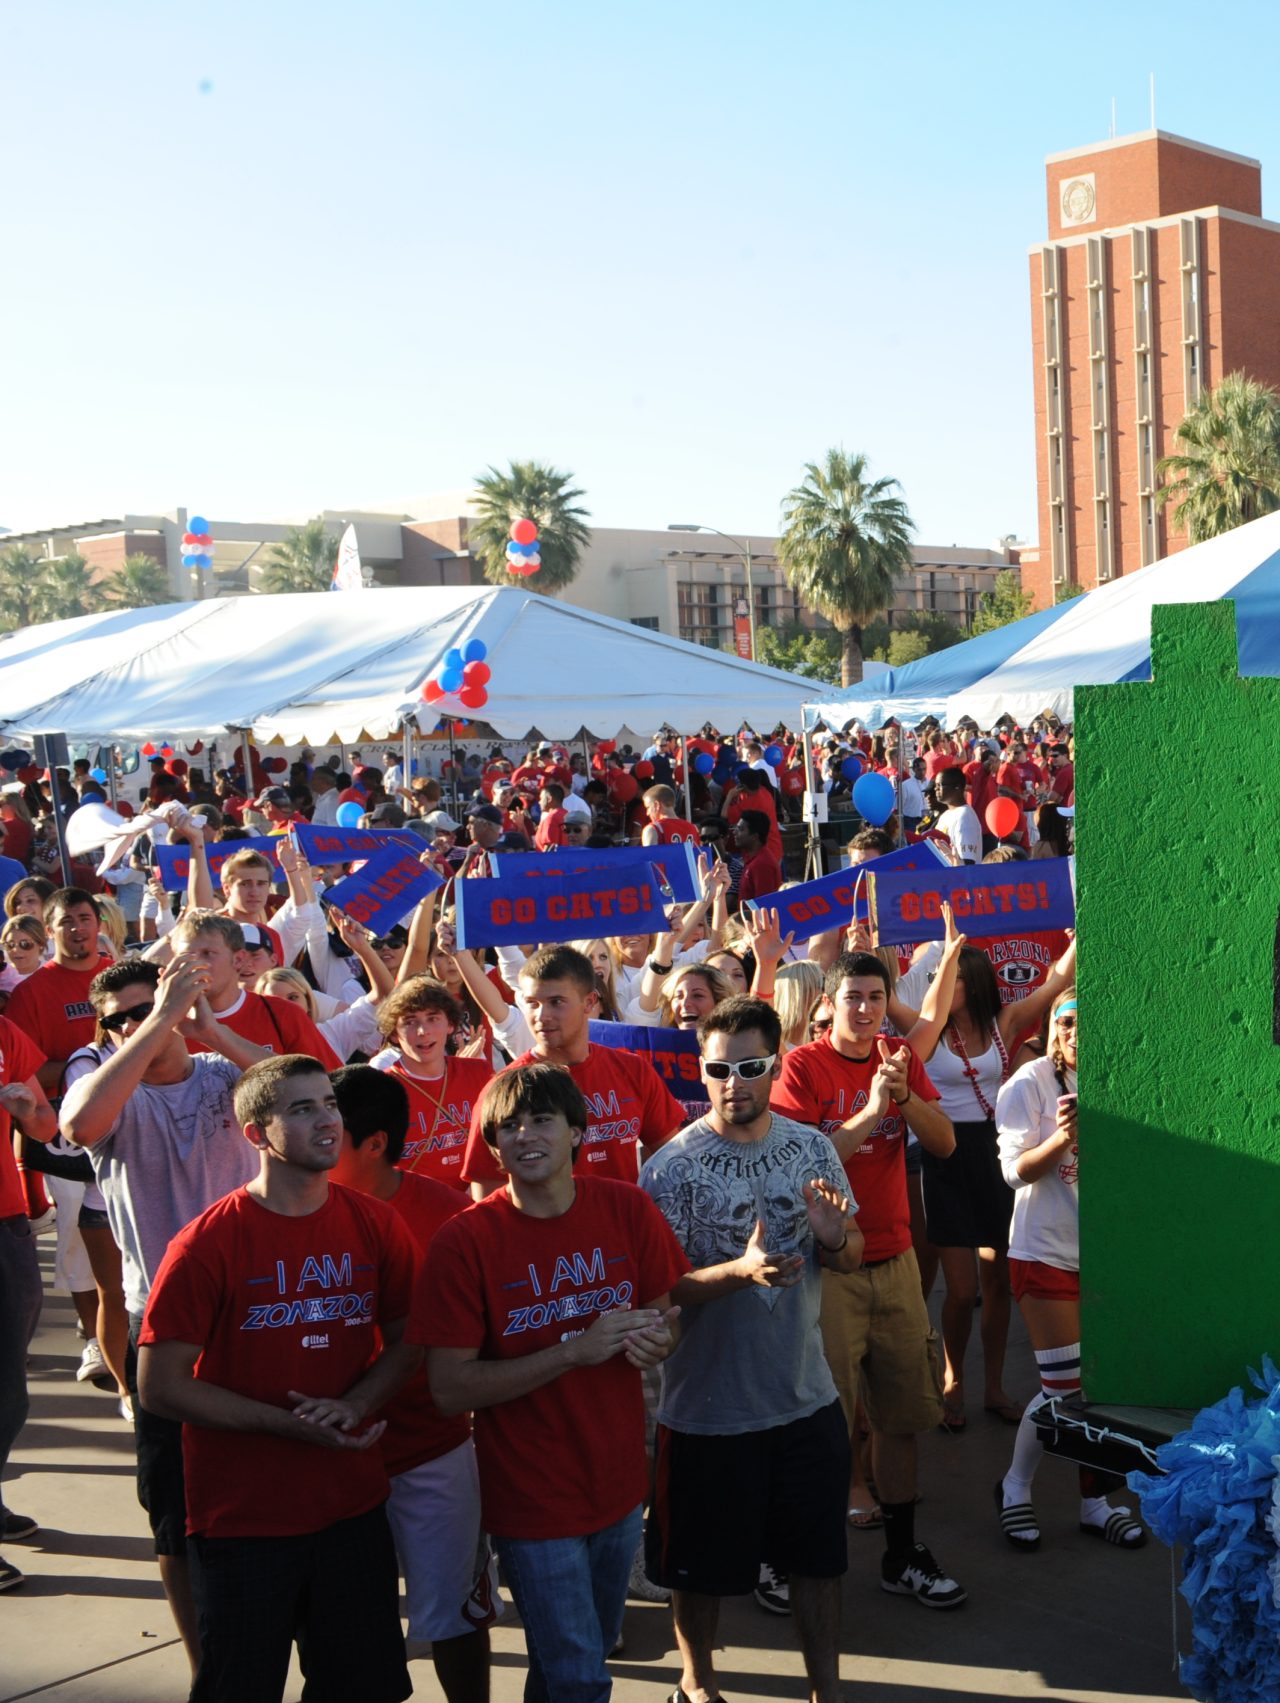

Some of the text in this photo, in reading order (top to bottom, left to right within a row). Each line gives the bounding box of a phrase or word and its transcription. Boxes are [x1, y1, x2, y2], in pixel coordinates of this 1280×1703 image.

[344, 894, 382, 922] GO
[491, 884, 653, 925] GO CATS!
[788, 895, 831, 922] GO
[901, 881, 1050, 922] GO CATS!
[418, 1100, 472, 1135] I AM
[838, 1089, 845, 1114] I
[699, 1137, 803, 1179] affliction
[276, 1252, 352, 1295] I AM
[528, 1247, 606, 1297] I AM
[239, 1291, 374, 1330] ZONAZOO
[502, 1280, 633, 1336] ZONAZOO
